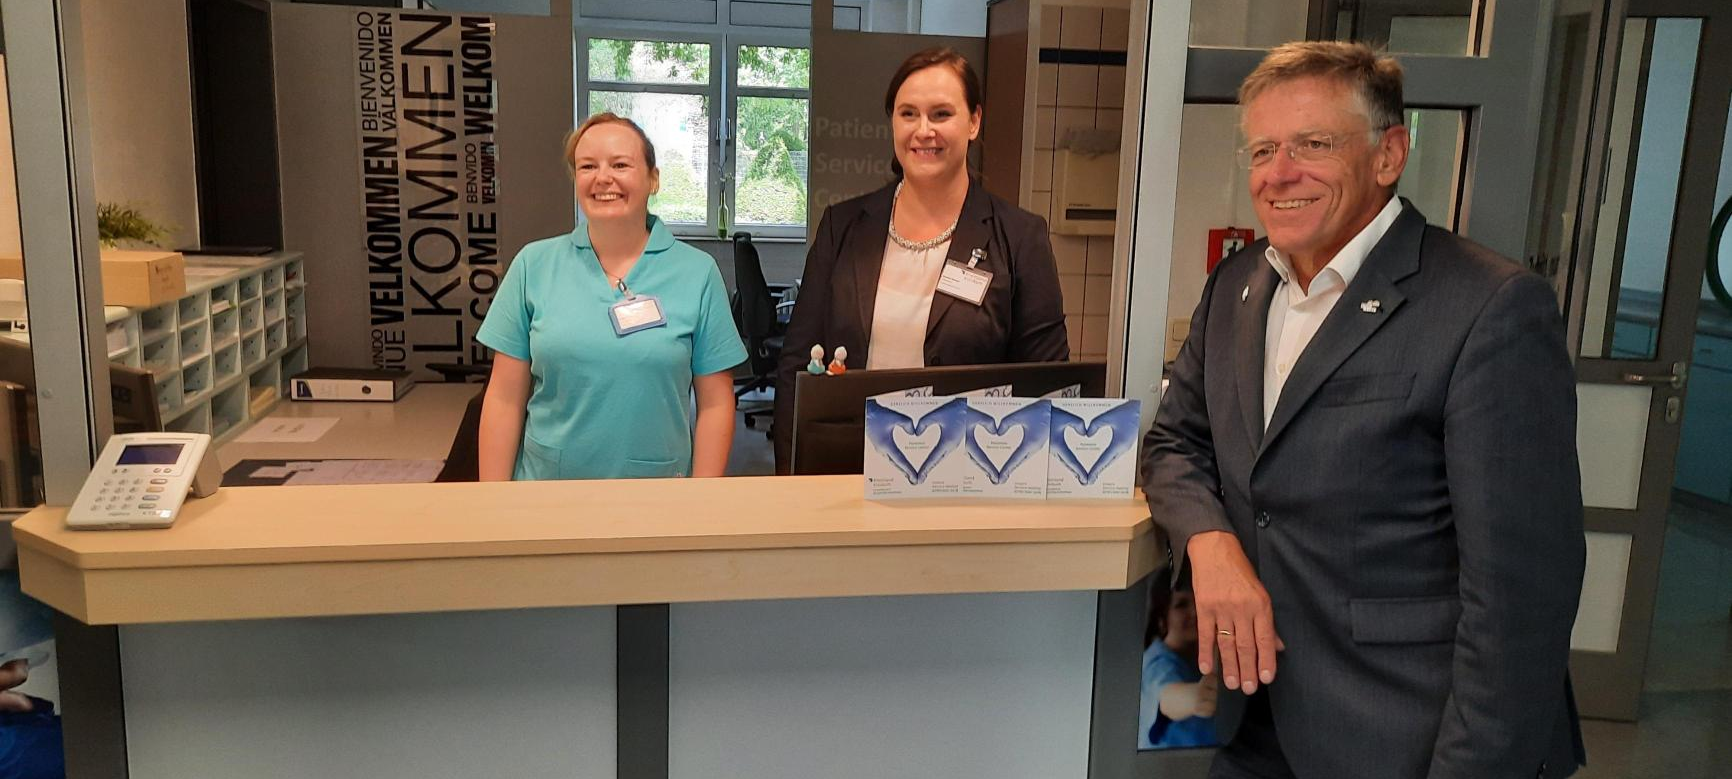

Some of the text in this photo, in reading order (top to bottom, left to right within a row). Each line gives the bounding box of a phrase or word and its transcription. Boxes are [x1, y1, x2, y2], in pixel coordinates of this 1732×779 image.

[357, 11, 379, 132] BIENVENIDO
[377, 12, 398, 133] VÄLKOMMEN
[460, 16, 494, 136] WELKOM
[815, 117, 888, 139] Patien
[362, 136, 405, 325] VELKOMMEN
[399, 13, 464, 366] LKOMMEN
[465, 142, 480, 204] BENVIDO
